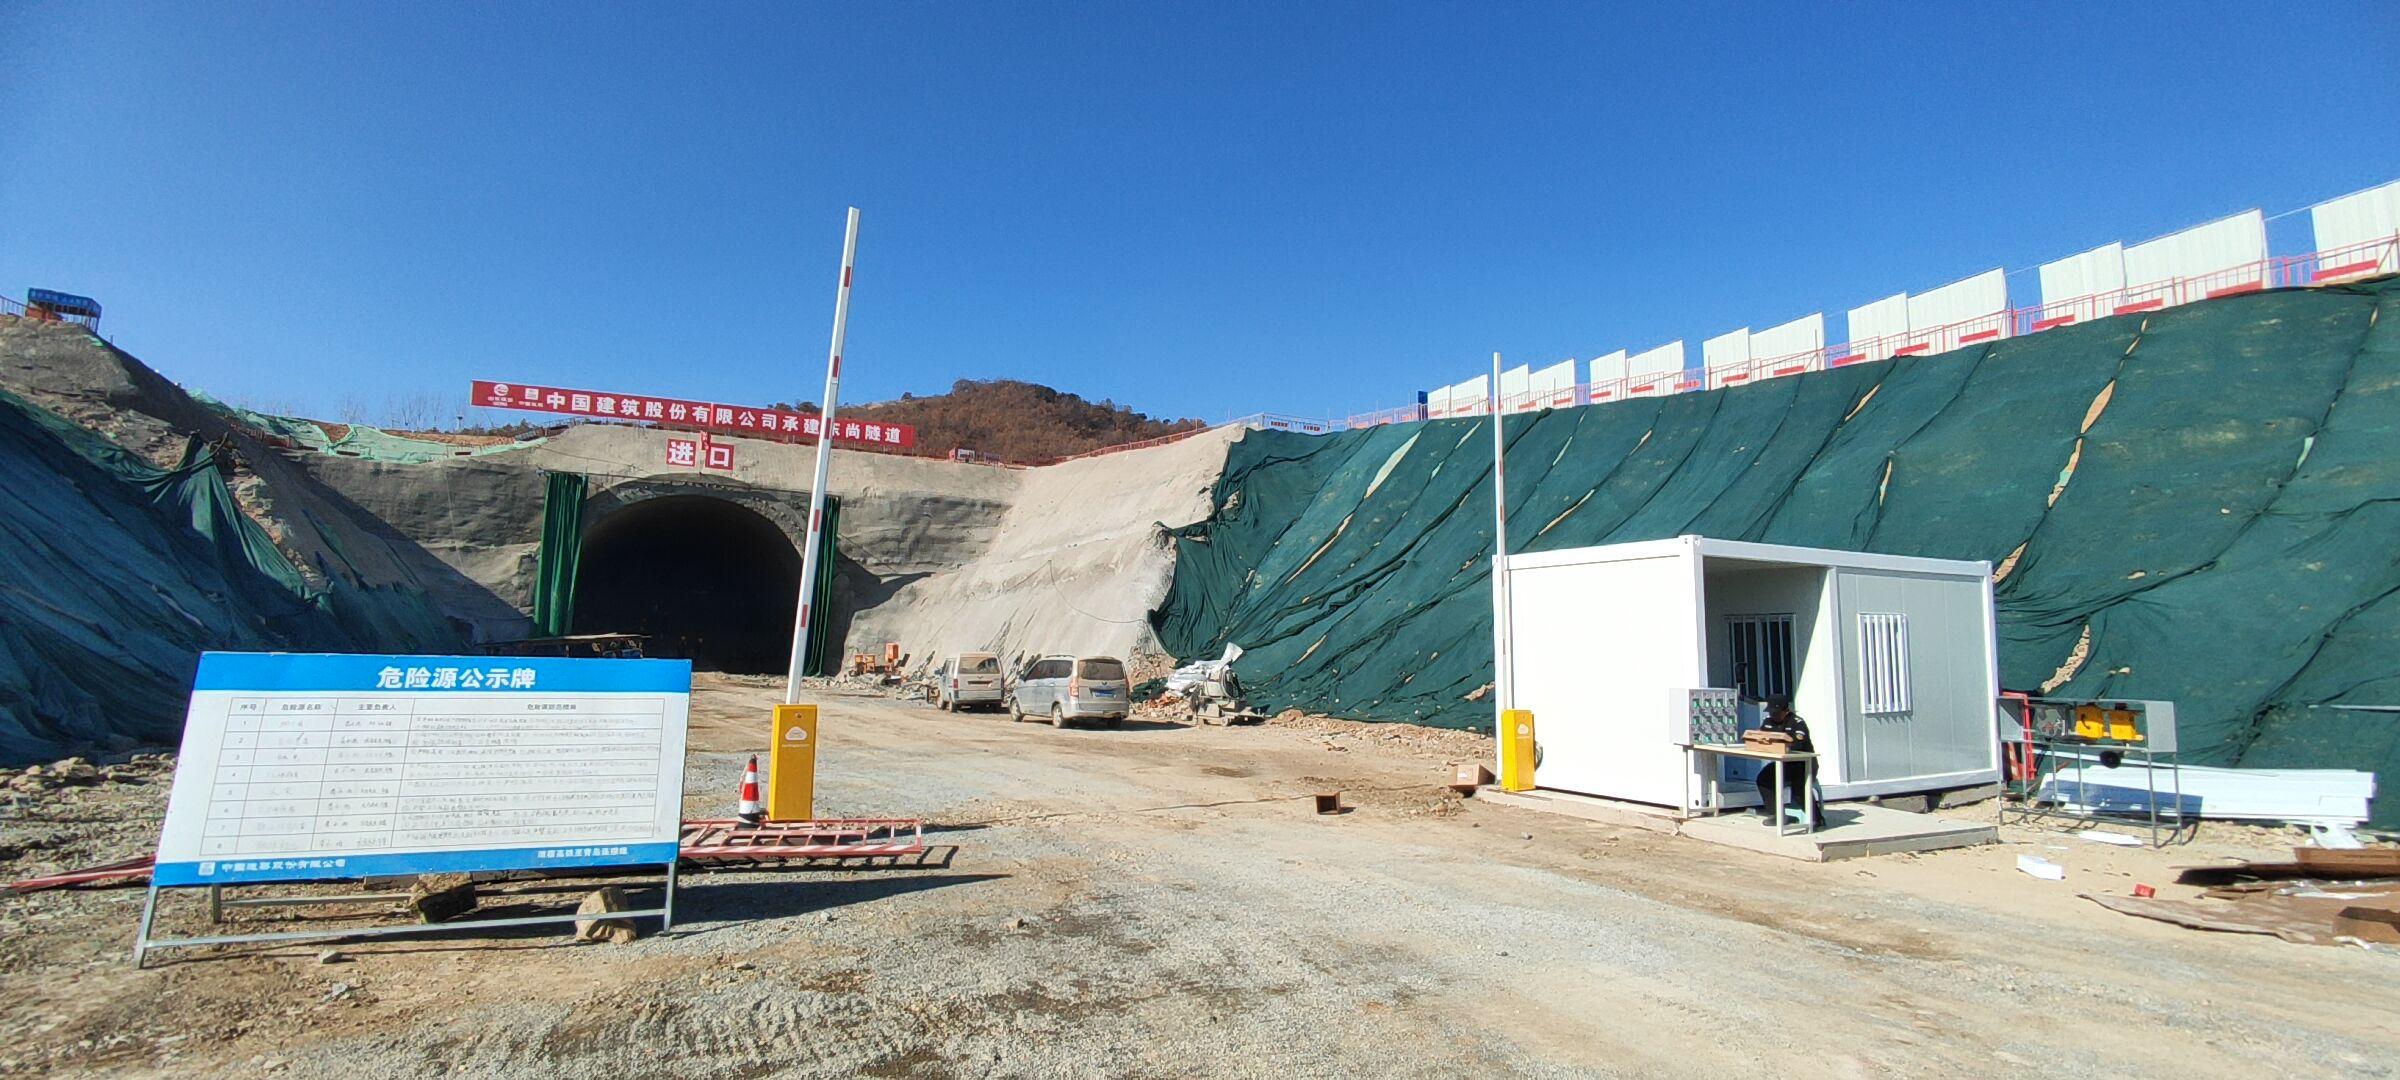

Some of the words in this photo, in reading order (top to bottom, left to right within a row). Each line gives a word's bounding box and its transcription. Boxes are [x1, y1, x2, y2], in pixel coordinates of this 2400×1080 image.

[668, 441, 730, 467] 进口
[376, 666, 536, 689] 危险源公示牌
